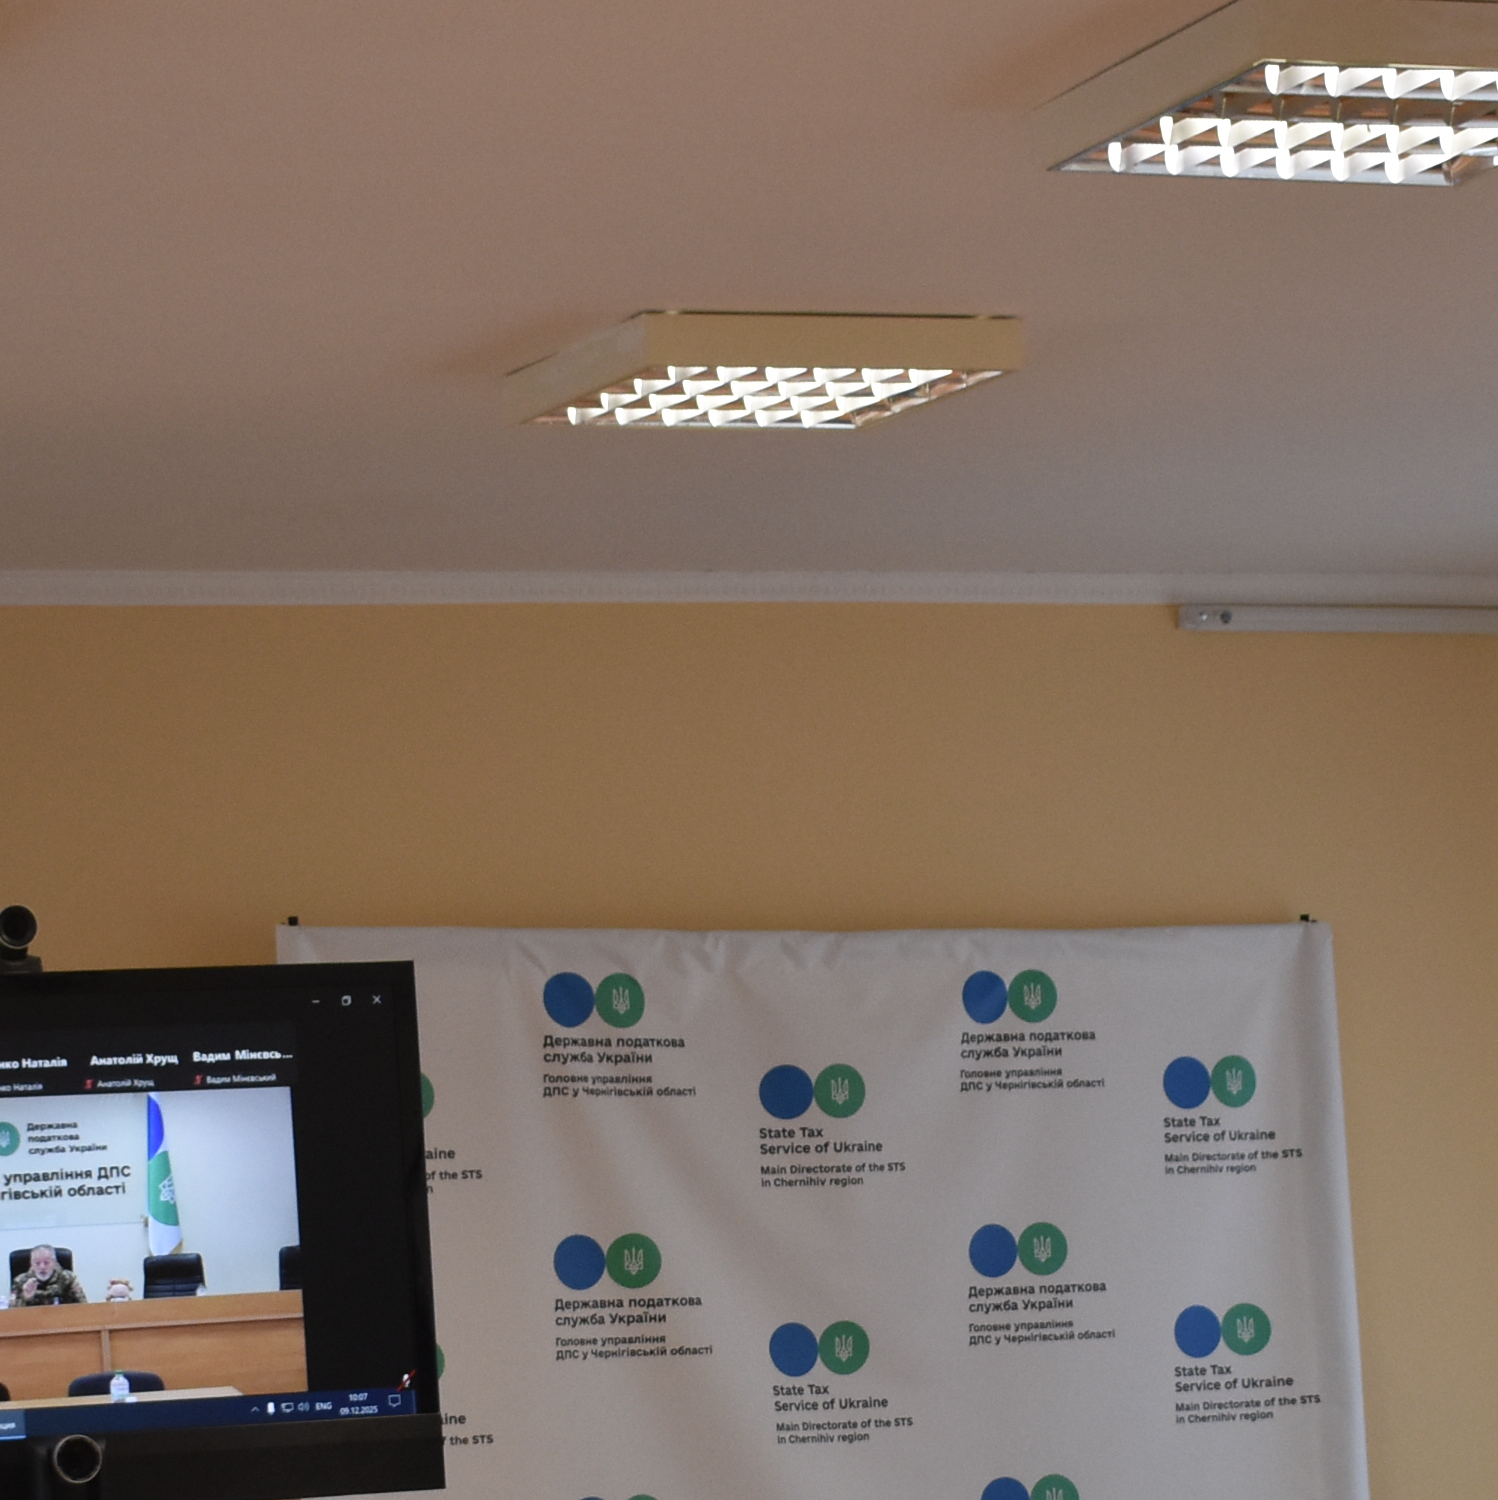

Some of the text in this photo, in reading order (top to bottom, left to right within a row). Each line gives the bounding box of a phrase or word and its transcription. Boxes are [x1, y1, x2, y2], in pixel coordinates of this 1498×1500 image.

[543, 1035, 685, 1048] Державна податкова
[961, 1031, 1095, 1044] Державна податкова
[193, 1051, 231, 1063] Вадим
[543, 1051, 653, 1065] служба України
[961, 1045, 1062, 1060] служба України
[22, 1057, 67, 1068] Наталія
[90, 1053, 179, 1066] Анатолій Хрущ
[543, 1074, 653, 1084] Головне управління
[543, 1086, 696, 1097] ДПС у Чернігівській області
[27, 1121, 78, 1131] Державна
[1164, 1116, 1220, 1128] State Tax
[28, 1134, 79, 1143] податкова
[759, 1127, 823, 1139] State Tax
[1164, 1130, 1275, 1143] Service of Ukraine
[29, 1144, 108, 1156] служба України
[425, 1148, 455, 1159] aine
[760, 1141, 883, 1154] Service of Ukraine
[761, 1162, 906, 1174] Main Directorate of the STS
[4, 1168, 92, 1186] управління
[97, 1165, 131, 1180] ДПС
[439, 1171, 458, 1179] the
[462, 1170, 482, 1179] STS
[762, 1176, 863, 1187] in Chernihiv region
[67, 1182, 126, 1197] області
[968, 1282, 1107, 1299] Державна податкова
[555, 1296, 702, 1311] Державна податкова
[969, 1298, 1073, 1314] служба України
[555, 1312, 666, 1328] служба України
[556, 1334, 666, 1346] Головне управління
[556, 1345, 713, 1361] ДПС у Чернігівській області
[1174, 1365, 1232, 1377] State Tax
[773, 1384, 829, 1396] State Tax
[1175, 1376, 1293, 1392] Service of Ukraine
[316, 1402, 332, 1411] ENG
[340, 1406, 378, 1415] 09.12.2025
[774, 1397, 888, 1412] Service of Ukraine
[776, 1418, 913, 1431] Main Directorate of the STS
[450, 1436, 469, 1445] the
[472, 1435, 494, 1444] STS
[777, 1432, 869, 1444] in Chernihiv region
